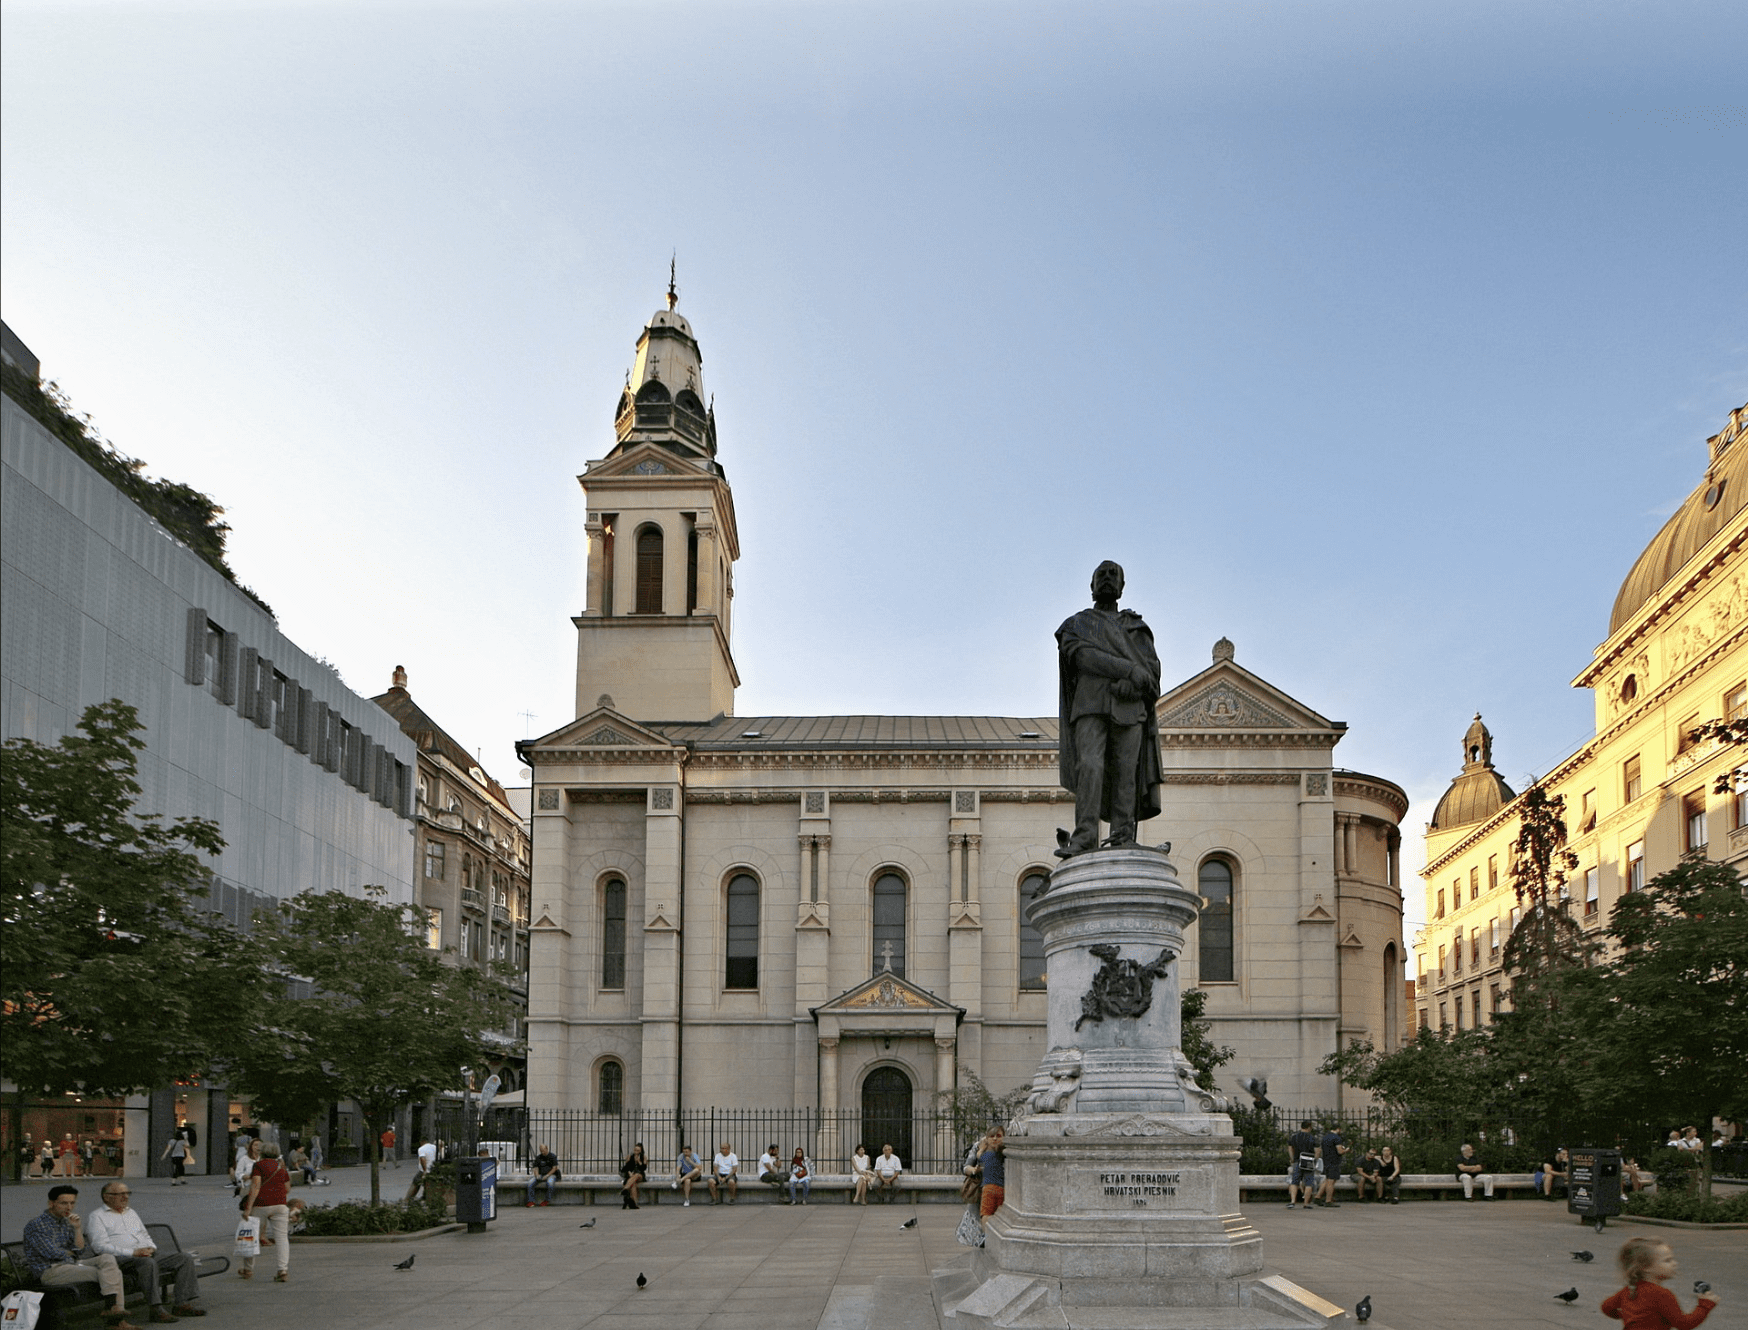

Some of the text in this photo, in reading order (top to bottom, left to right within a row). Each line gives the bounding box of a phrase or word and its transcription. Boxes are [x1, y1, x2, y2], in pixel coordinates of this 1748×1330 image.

[1100, 1171, 1180, 1184] PETAR PRERADOVIĆ
[1104, 1186, 1141, 1196] HRVATSKI
